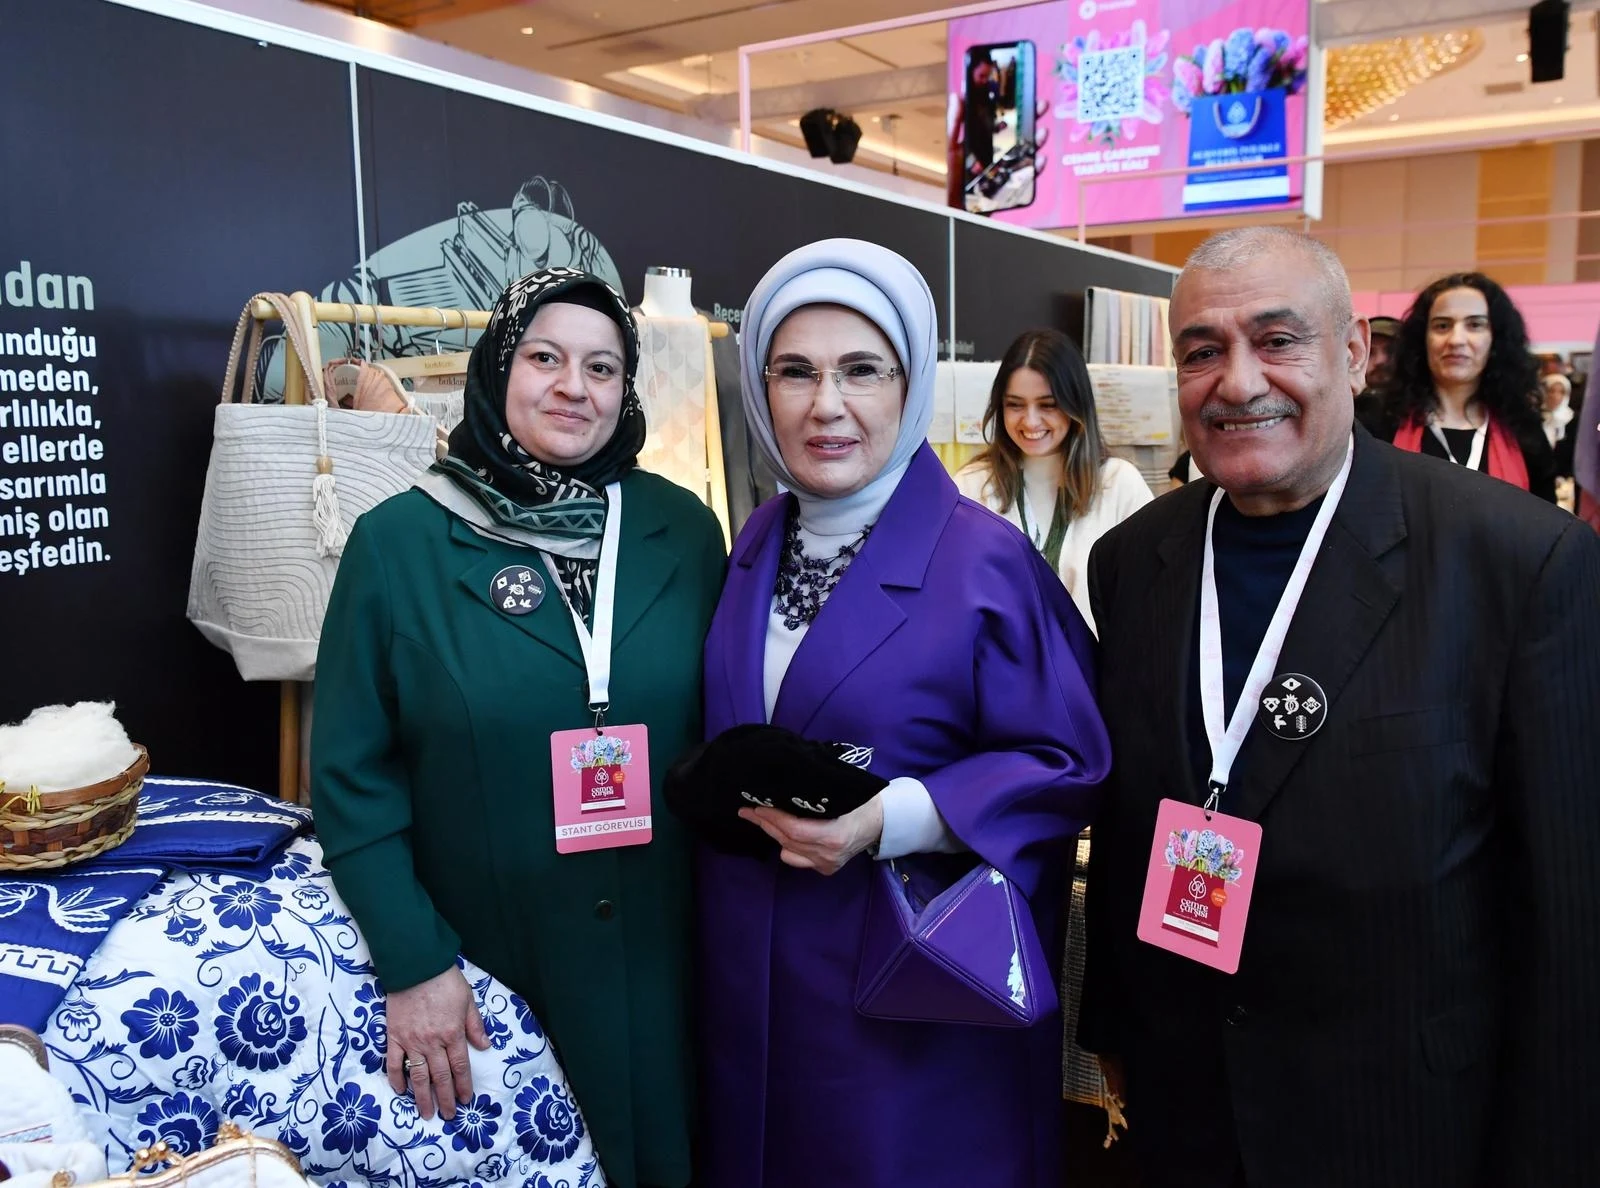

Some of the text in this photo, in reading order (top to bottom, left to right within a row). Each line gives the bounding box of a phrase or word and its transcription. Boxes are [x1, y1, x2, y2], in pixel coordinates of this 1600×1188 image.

[0, 261, 95, 310] dan
[0, 326, 97, 363] nduğu
[2, 433, 104, 464] ellerde
[0, 467, 106, 500] sarımla
[48, 503, 109, 532] olan
[0, 536, 111, 576] eşfedin.
[562, 819, 646, 836] STANT GÖREVLİSİ
